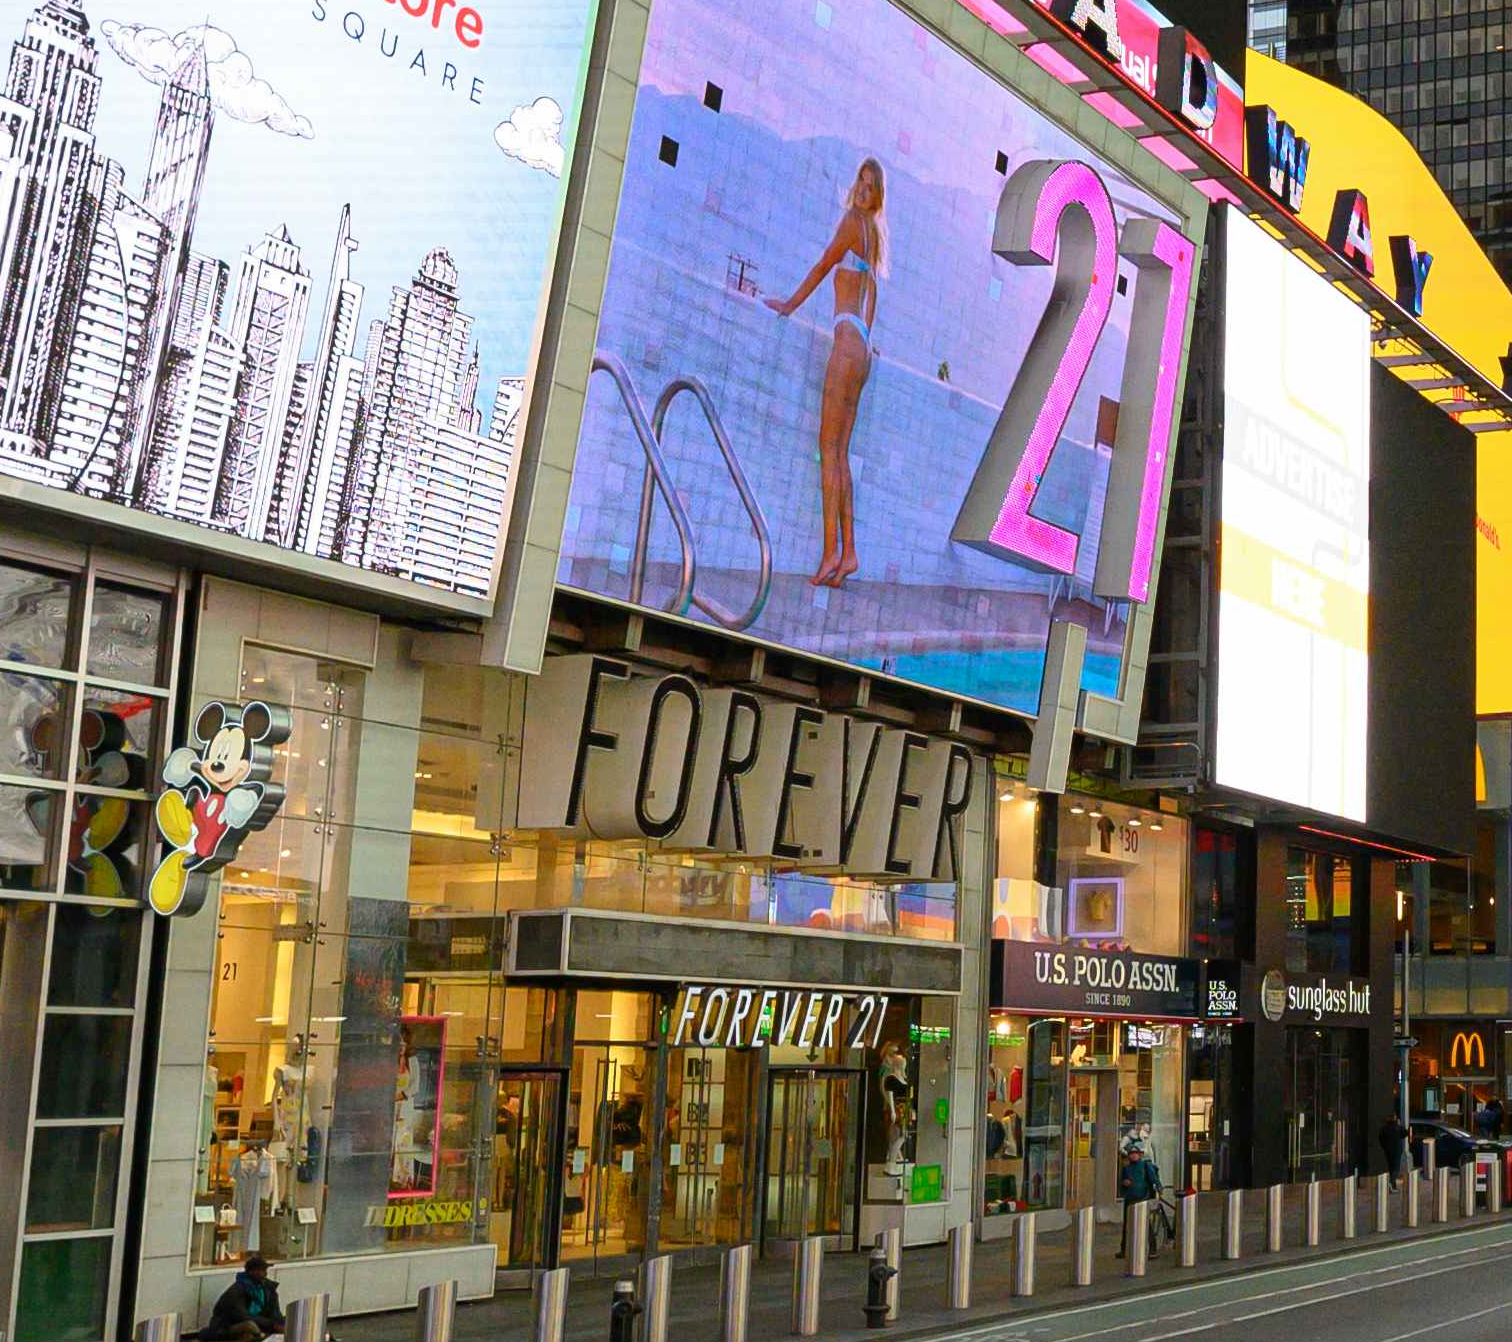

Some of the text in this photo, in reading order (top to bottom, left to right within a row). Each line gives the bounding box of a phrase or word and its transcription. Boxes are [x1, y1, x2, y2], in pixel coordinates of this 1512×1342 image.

[1119, 43, 1152, 92] ual
[973, 159, 1196, 606] 21
[543, 653, 974, 884] FOREVER
[221, 962, 239, 983] 21
[1034, 951, 1180, 993] U.S. POLO ASSN.
[1208, 980, 1228, 991] U.S.
[1085, 992, 1131, 1007] SINCE 1890
[1208, 990, 1237, 1001] POLO
[1208, 1000, 1238, 1010] ASSN.
[1288, 978, 1371, 1021] sunglass hut
[674, 986, 890, 1049] FOREVER 21
